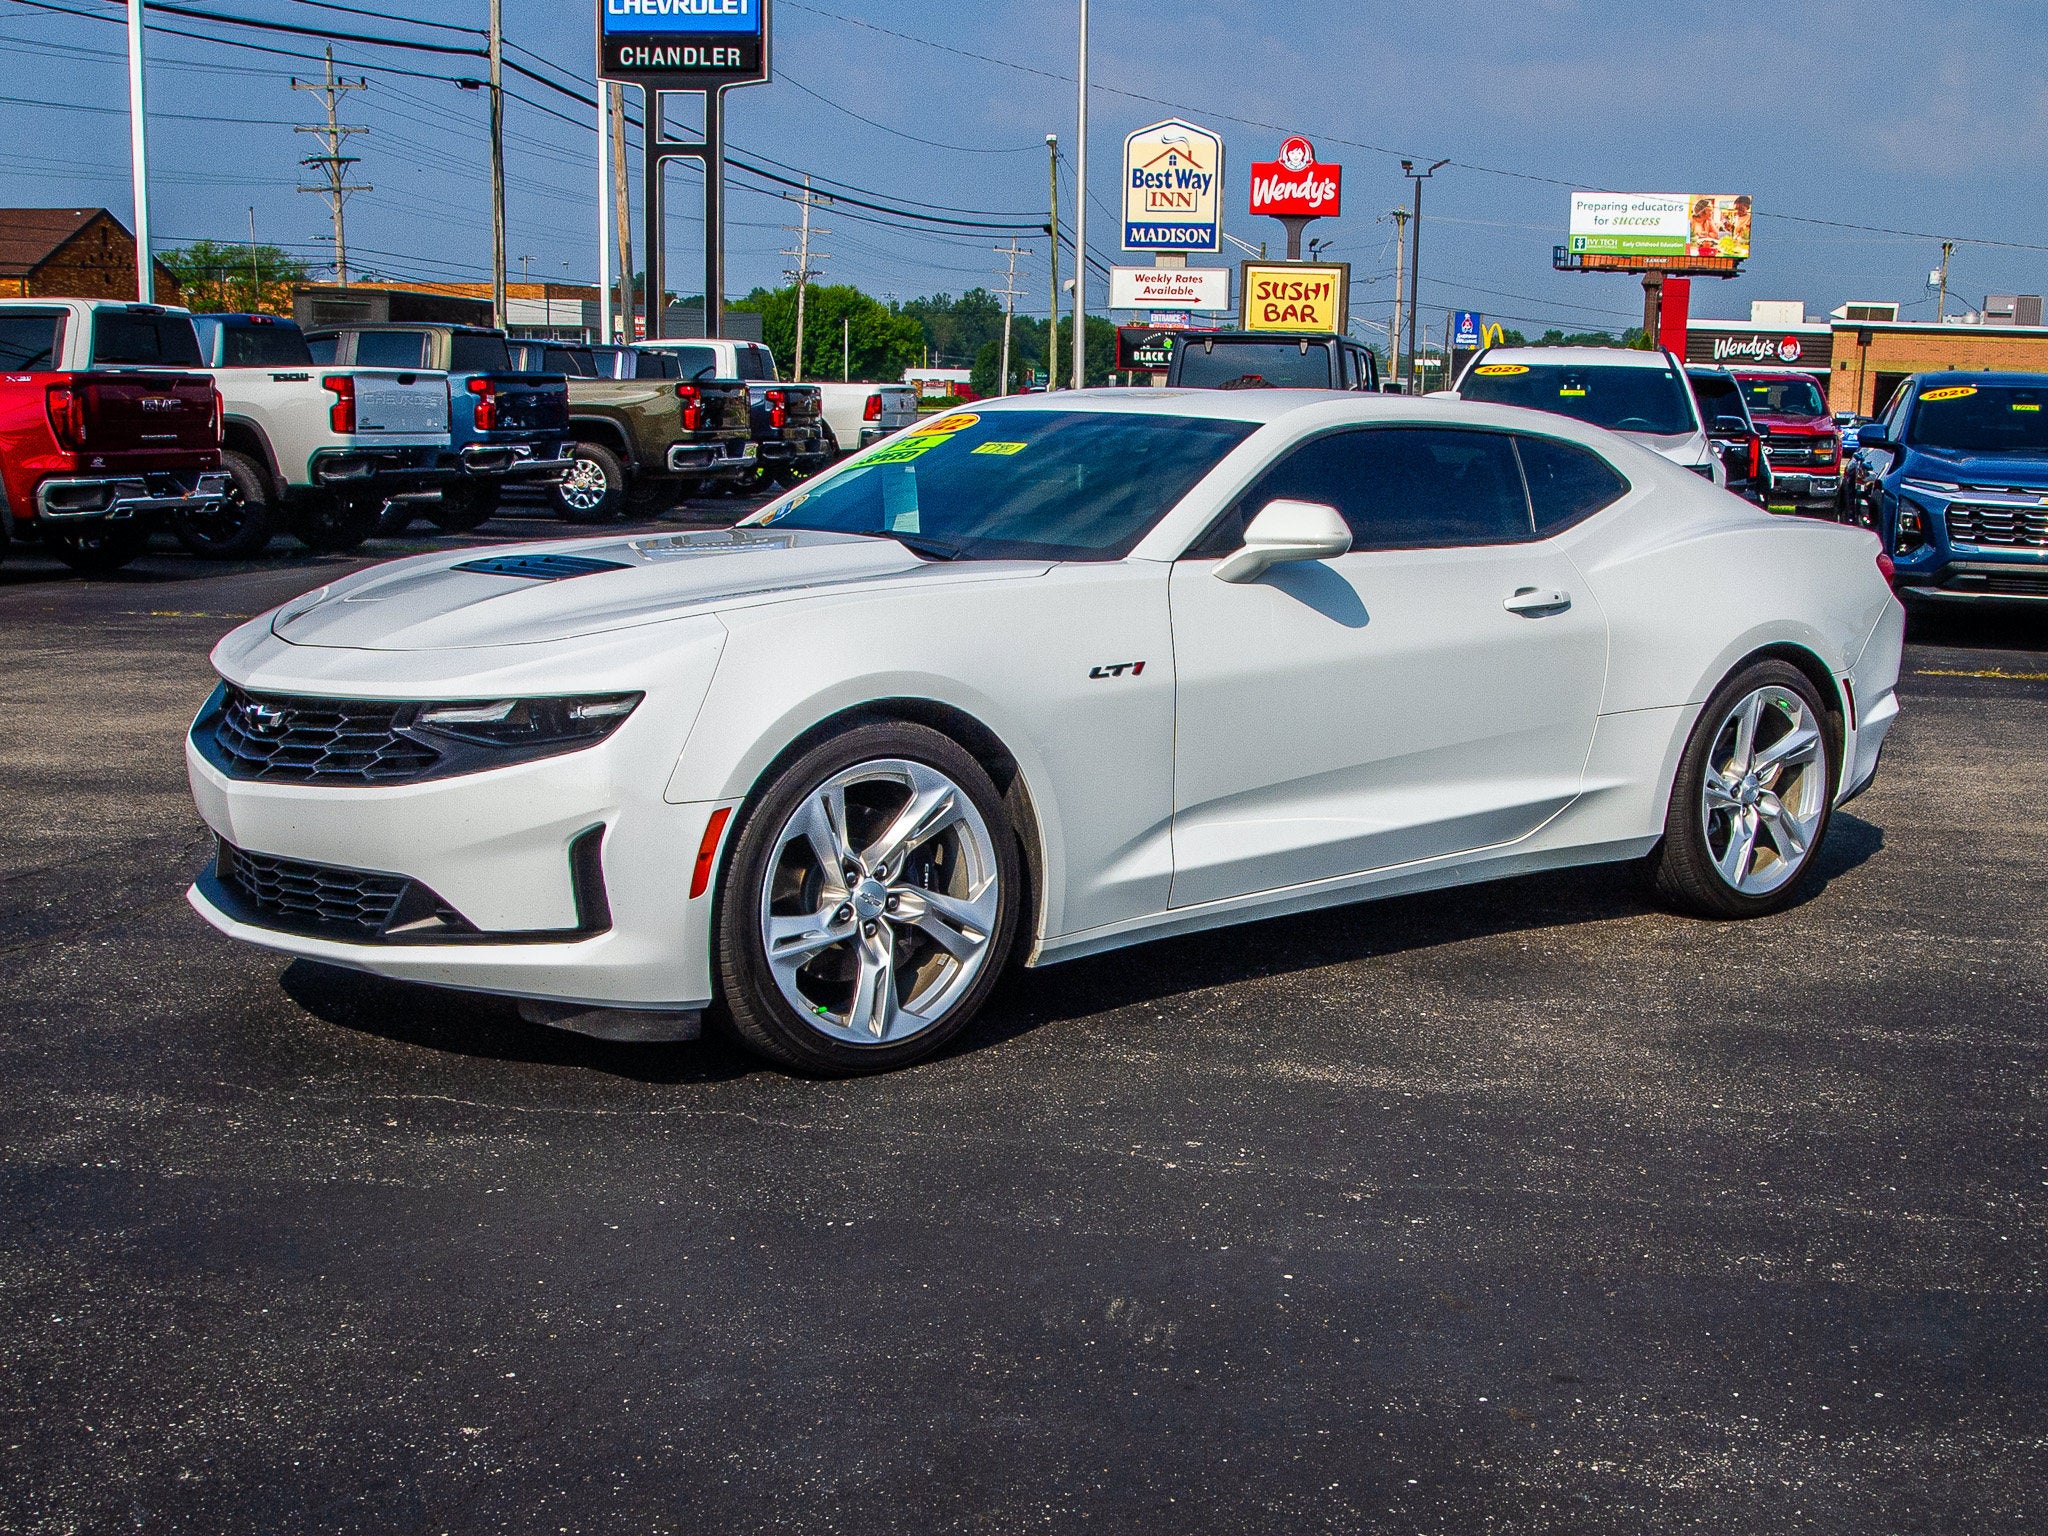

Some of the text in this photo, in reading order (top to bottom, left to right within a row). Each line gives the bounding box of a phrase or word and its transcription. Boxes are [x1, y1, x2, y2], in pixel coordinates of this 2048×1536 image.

[608, 0, 748, 15] CHEVROLET
[620, 46, 741, 66] CHANDLER
[1132, 168, 1213, 196] Best Way
[1253, 171, 1336, 207] Wendy's
[1150, 191, 1192, 207] INN
[1577, 201, 1684, 214] Preparing educators
[1594, 215, 1661, 226] for success
[1130, 227, 1211, 243] MADISON
[1135, 274, 1203, 284] Weekly Rates
[1143, 286, 1194, 295] Available
[1256, 281, 1330, 301] SUSHI
[1264, 303, 1319, 323] BAR
[1713, 334, 1775, 361] Wendy's
[1133, 350, 1165, 362] BLACK
[1928, 389, 1970, 400] 2026
[1088, 661, 1146, 679] LT1
